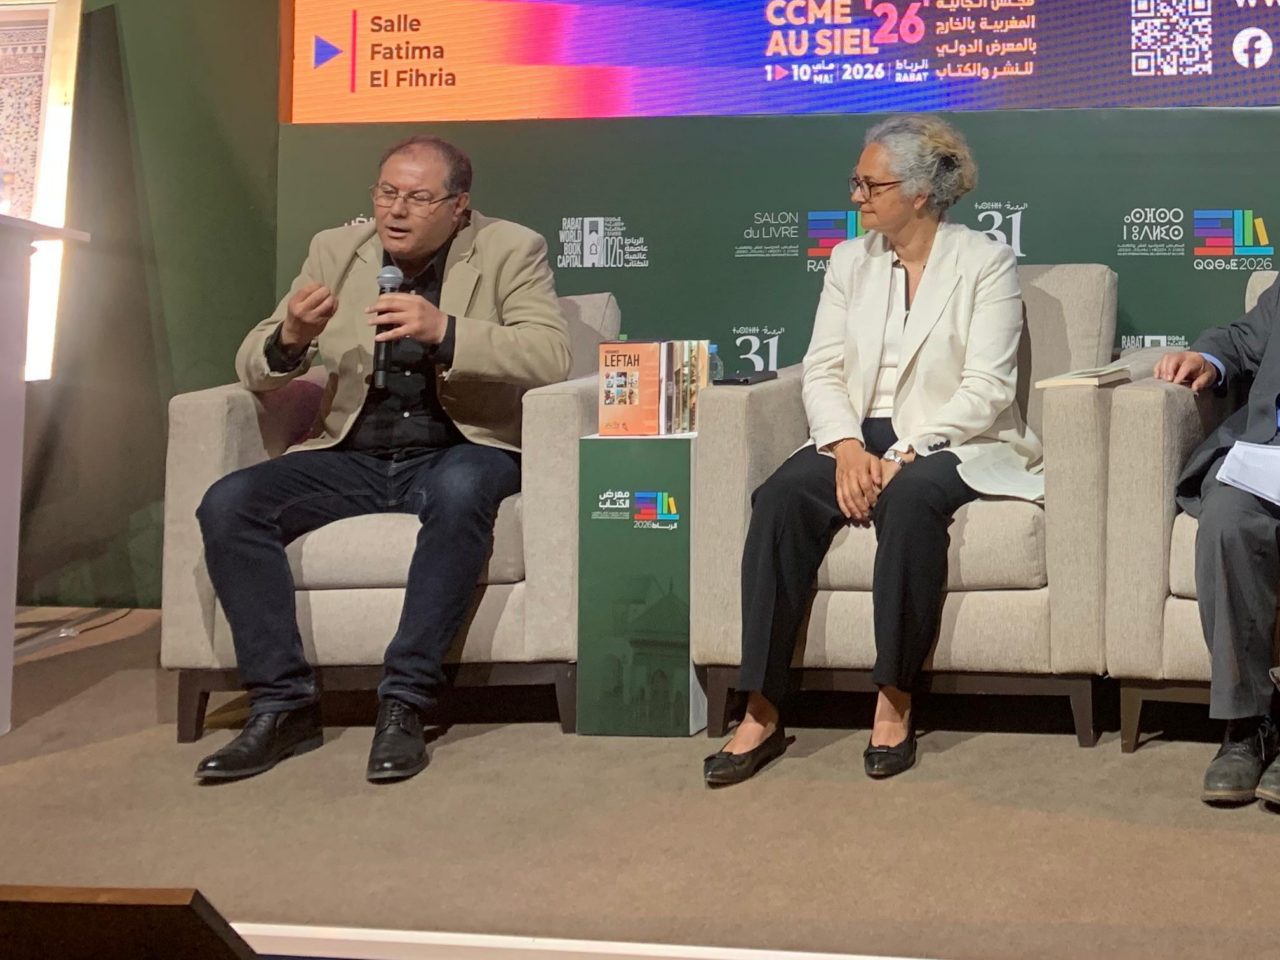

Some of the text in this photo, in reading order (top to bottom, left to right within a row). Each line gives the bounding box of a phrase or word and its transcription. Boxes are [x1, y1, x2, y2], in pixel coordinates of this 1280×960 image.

[370, 14, 421, 33] Salle
[936, 16, 976, 34] بالخارج
[370, 41, 444, 60] Fatima
[765, 28, 879, 56] AU SIEL
[985, 38, 1037, 56] بالمعرض
[370, 68, 456, 87] El Fihria
[765, 65, 773, 81] 1
[792, 64, 811, 82] 10
[842, 63, 886, 80] 2026
[895, 72, 929, 83] RABAT
[754, 211, 799, 224] SALON
[559, 230, 583, 243] WORLD
[744, 226, 799, 238] du LIVRE
[978, 210, 1026, 257] 31
[564, 243, 582, 255] BOOK
[557, 255, 583, 268] CAPITAL
[604, 354, 640, 367] LEFTAH
[735, 335, 779, 371] 31
